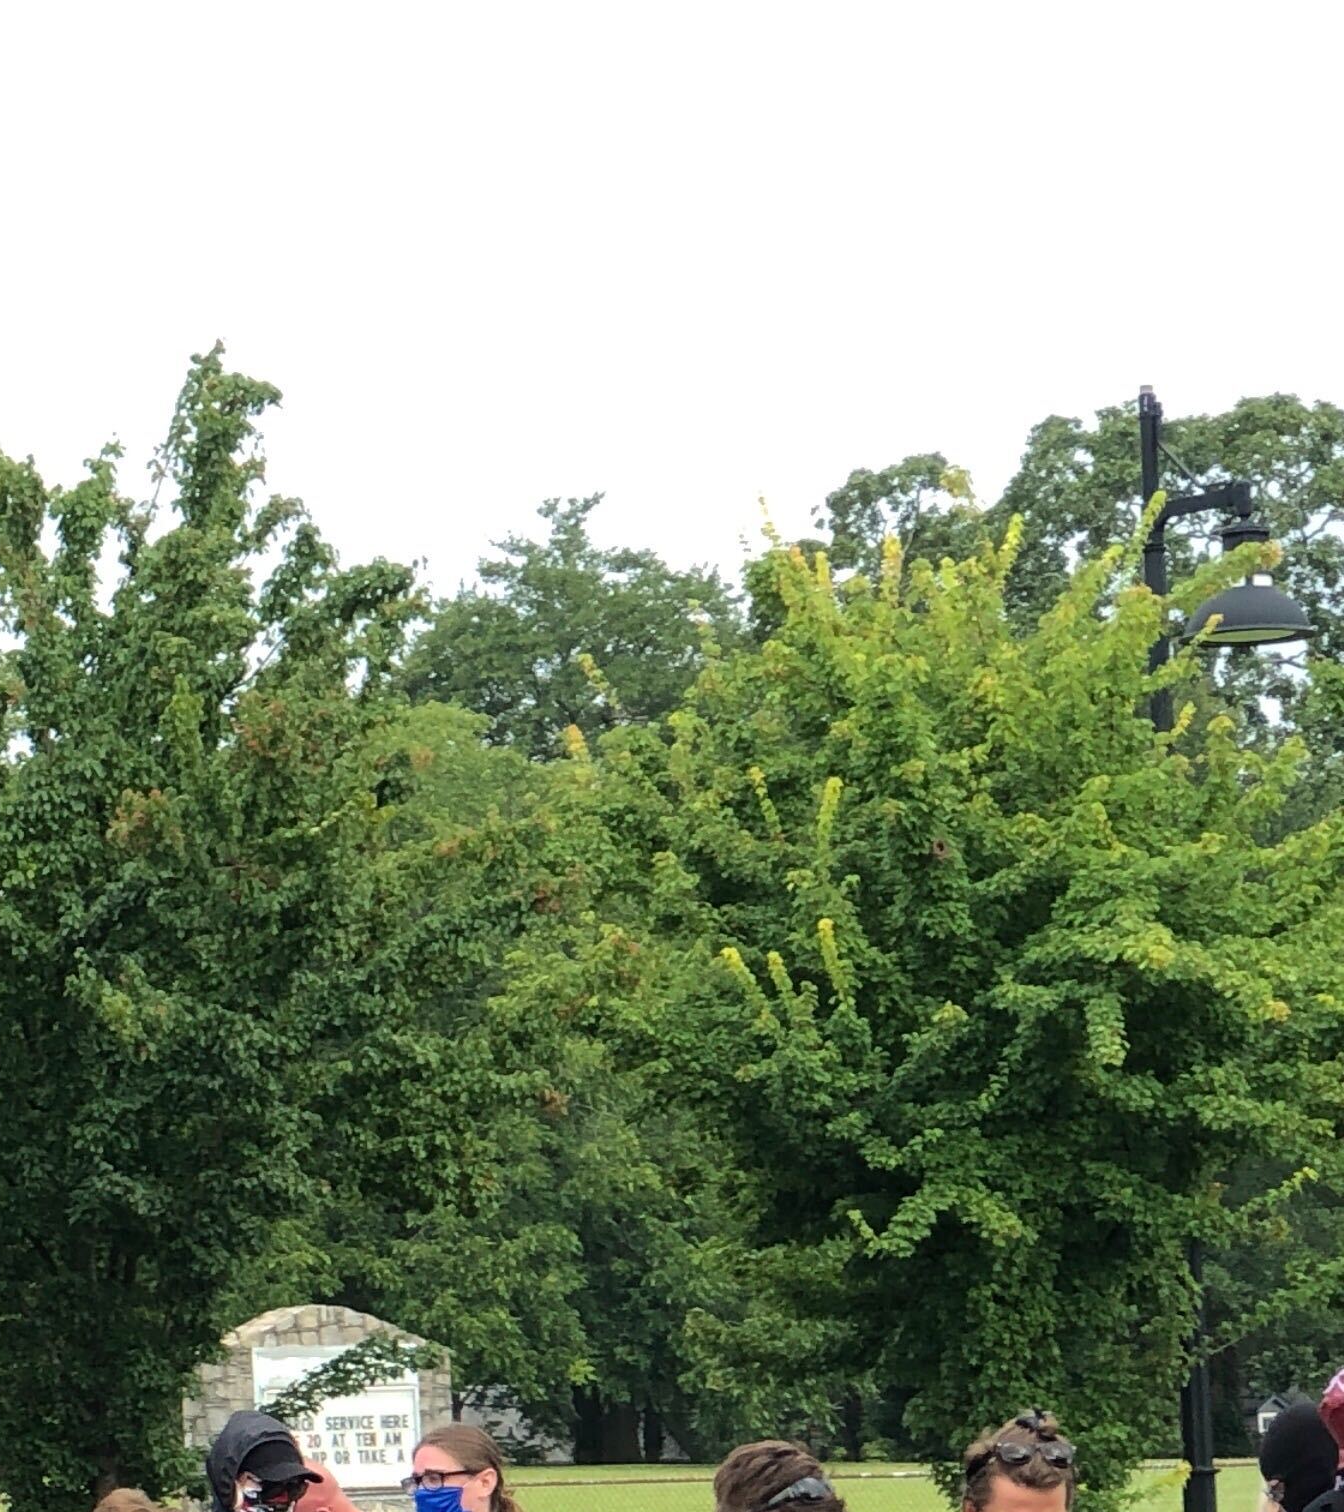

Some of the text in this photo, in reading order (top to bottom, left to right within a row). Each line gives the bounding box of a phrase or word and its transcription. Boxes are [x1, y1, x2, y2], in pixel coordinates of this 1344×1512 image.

[325, 1416, 374, 1431] SERVICE
[380, 1414, 409, 1428] HERE
[332, 1434, 345, 1448] AT
[355, 1433, 377, 1447] TEN
[384, 1432, 402, 1446] AM
[334, 1451, 351, 1464] OR
[397, 1449, 405, 1462] A
